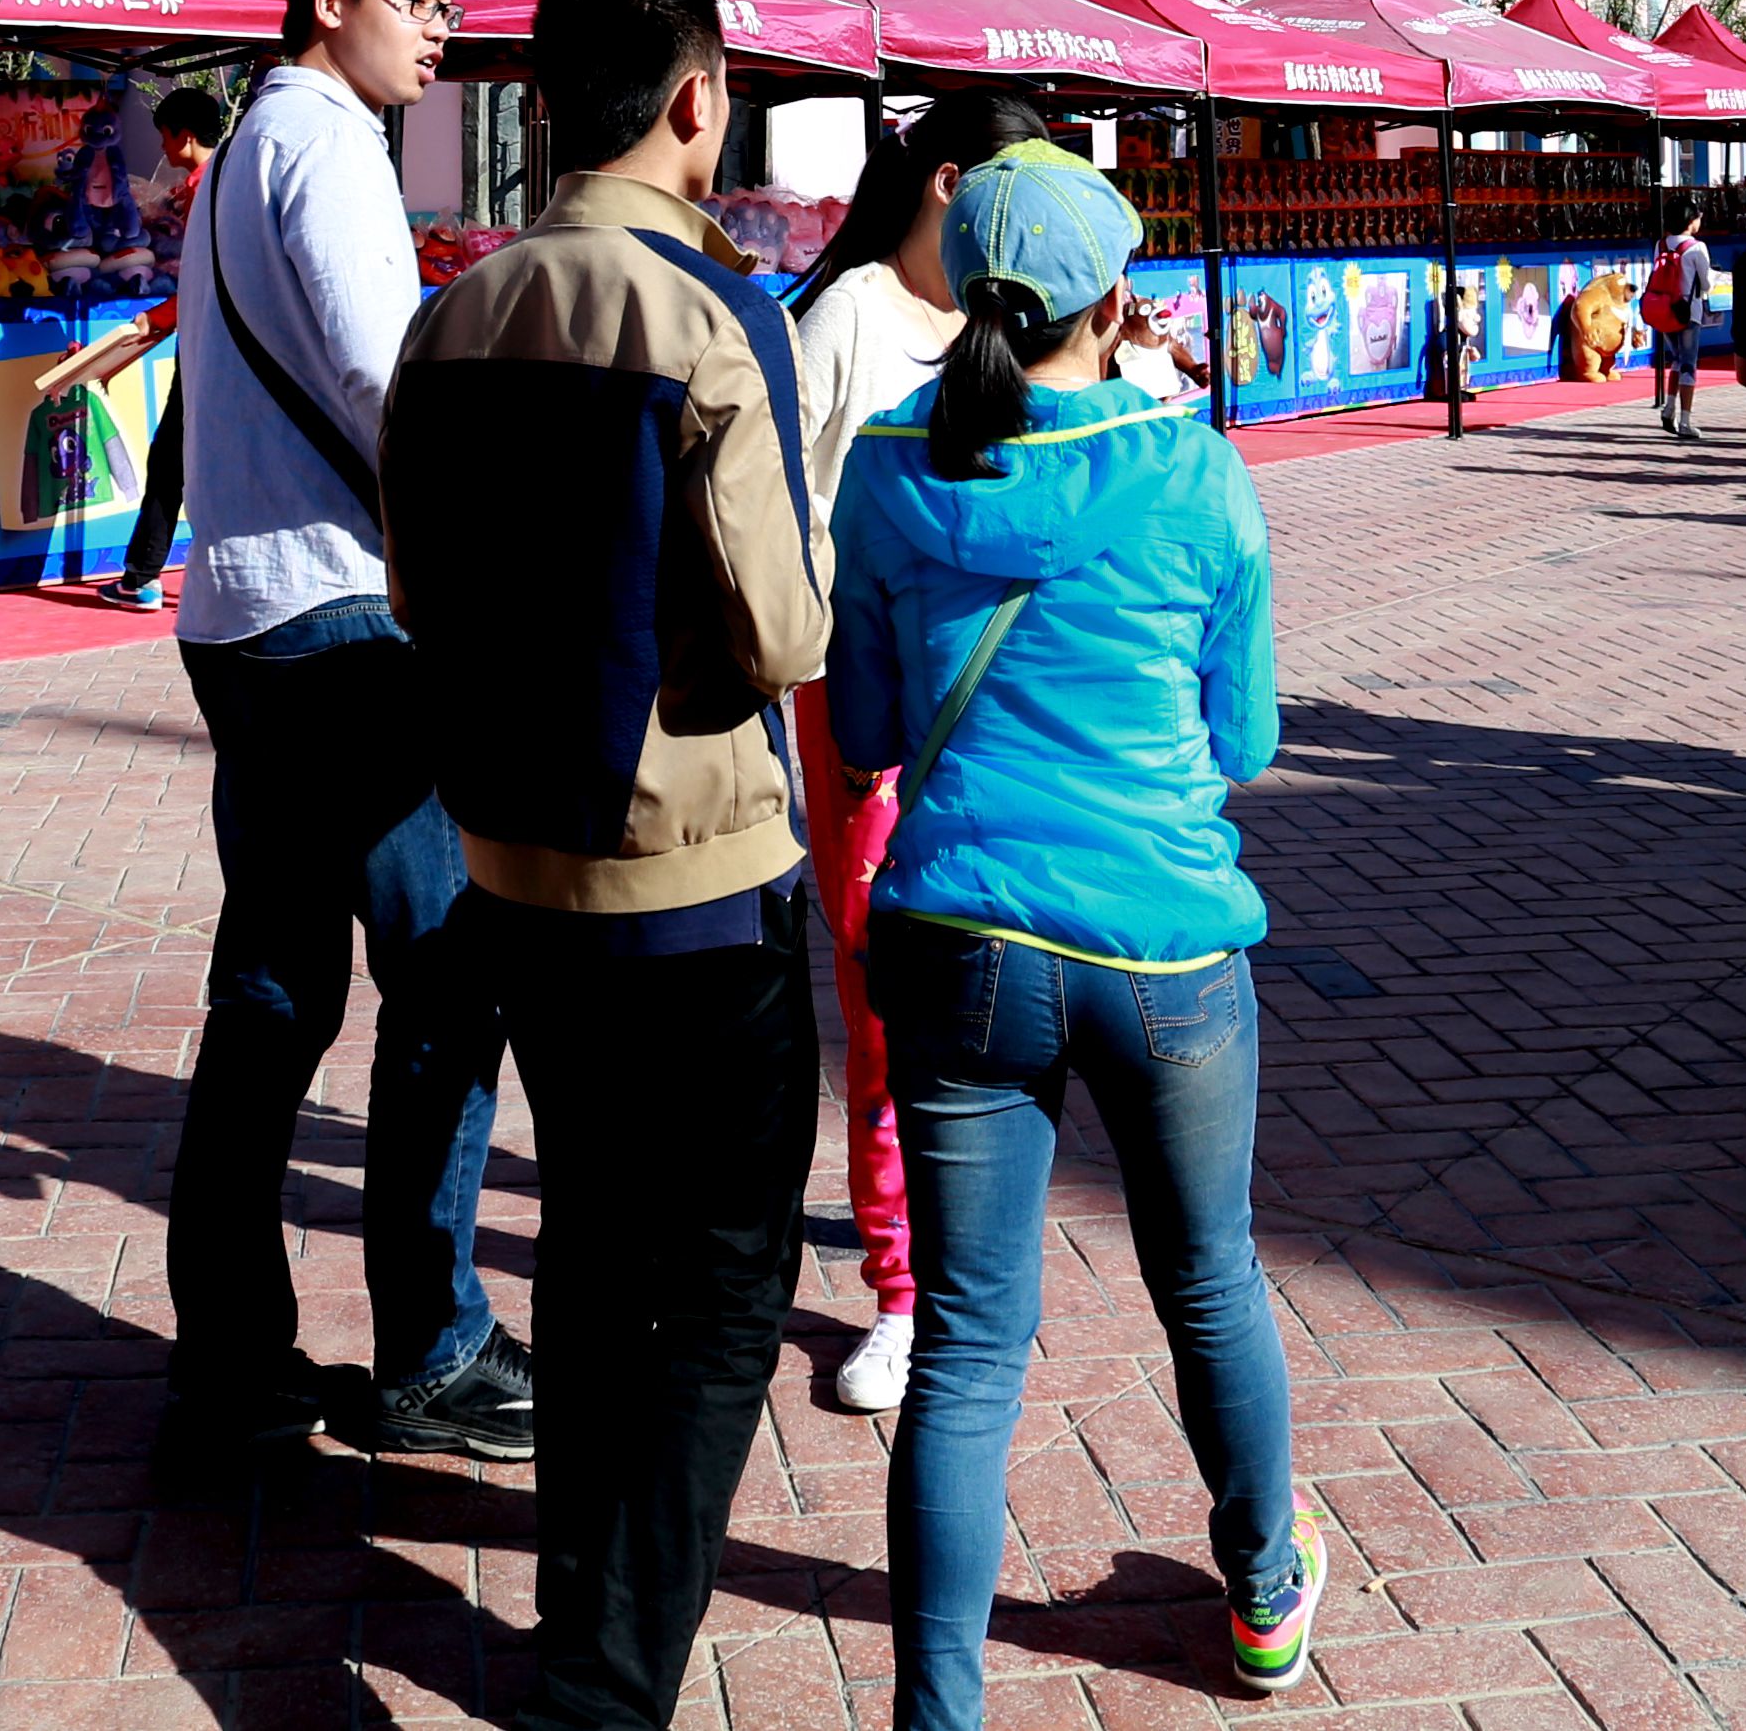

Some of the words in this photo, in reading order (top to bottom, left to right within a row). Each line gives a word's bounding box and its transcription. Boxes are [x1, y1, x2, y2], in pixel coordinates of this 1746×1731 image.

[982, 27, 1124, 68] 嘉峪关方特欢乐世界
[1283, 60, 1385, 96] 嘉峪关方特欢乐世界
